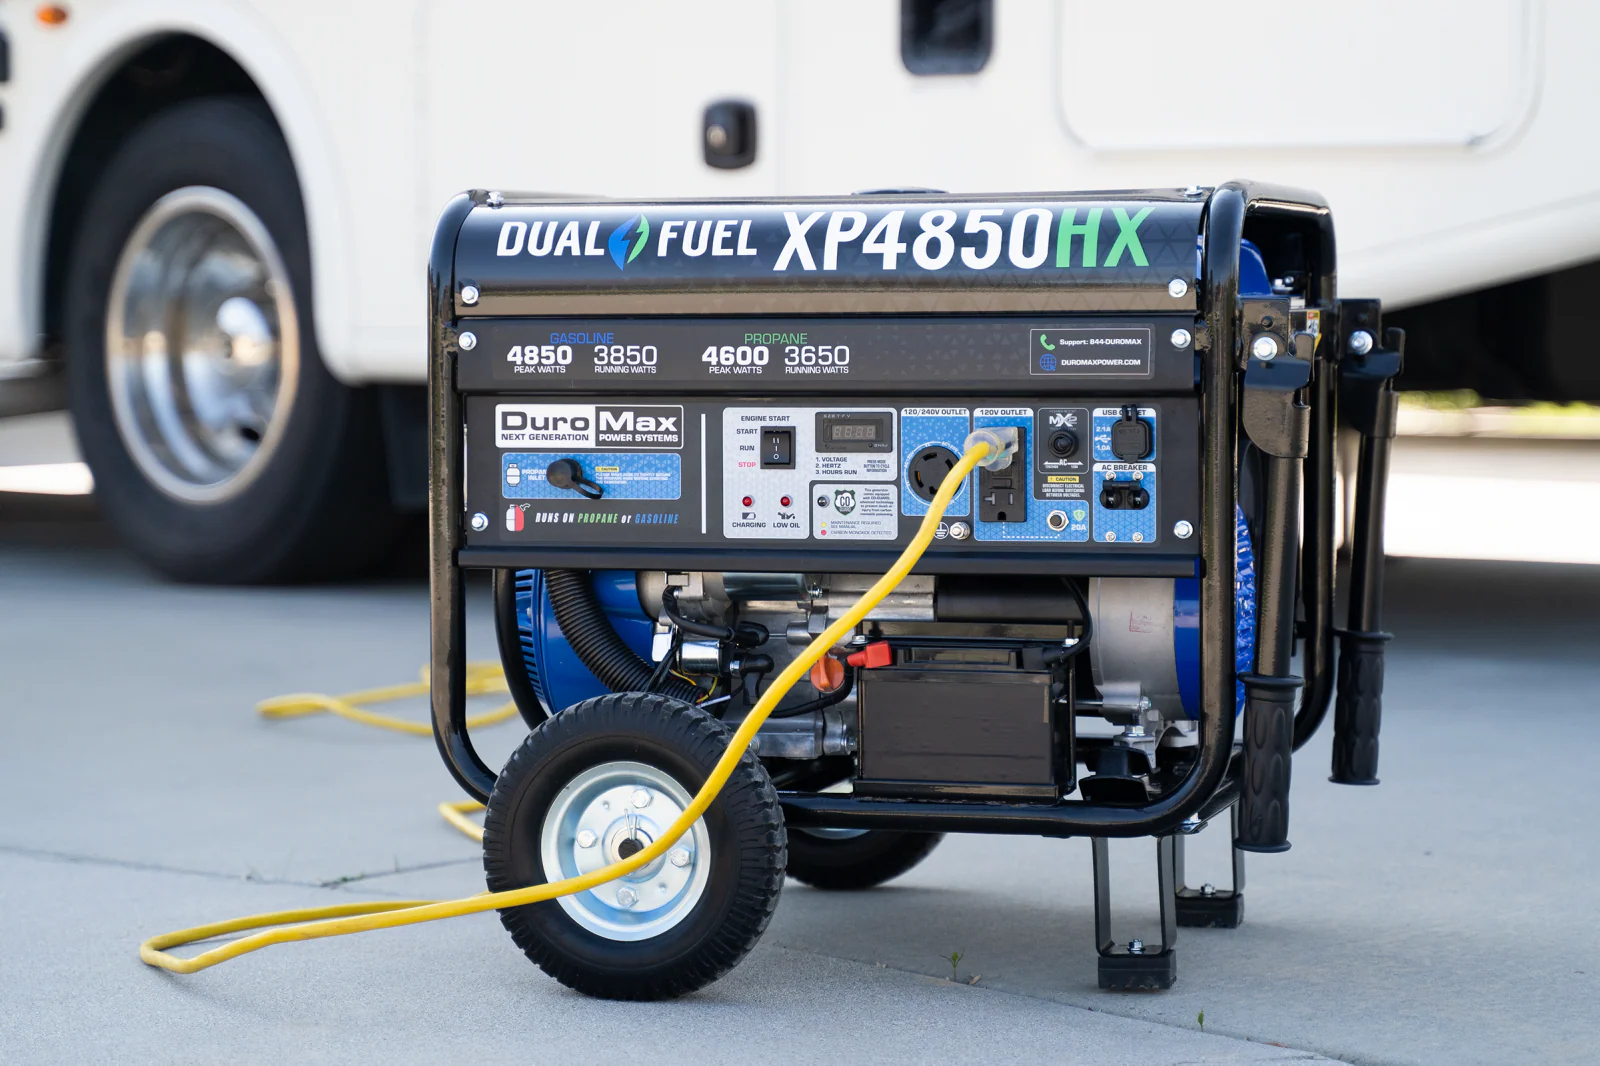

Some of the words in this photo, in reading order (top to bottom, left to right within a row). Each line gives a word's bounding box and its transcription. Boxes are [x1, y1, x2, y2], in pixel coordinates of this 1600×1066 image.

[496, 220, 605, 256] DUAL
[657, 220, 758, 257] FUEL
[773, 207, 1156, 270] XP4850HX
[550, 332, 614, 344] GASOLINE
[744, 333, 808, 344] PROPANE
[507, 346, 572, 365] 4850
[594, 346, 658, 365] 3850
[702, 346, 770, 366] 4600
[784, 346, 850, 366] 3650
[501, 412, 590, 432] Duro
[599, 412, 678, 432] Max
[599, 434, 632, 442] POWER
[635, 434, 678, 442] SYSTEMS
[840, 496, 850, 507] CO
[535, 513, 559, 523] RUNS
[562, 513, 574, 523] ON
[578, 513, 618, 523] PROPANE
[621, 515, 632, 524] or
[635, 514, 678, 524] GASOLINE
